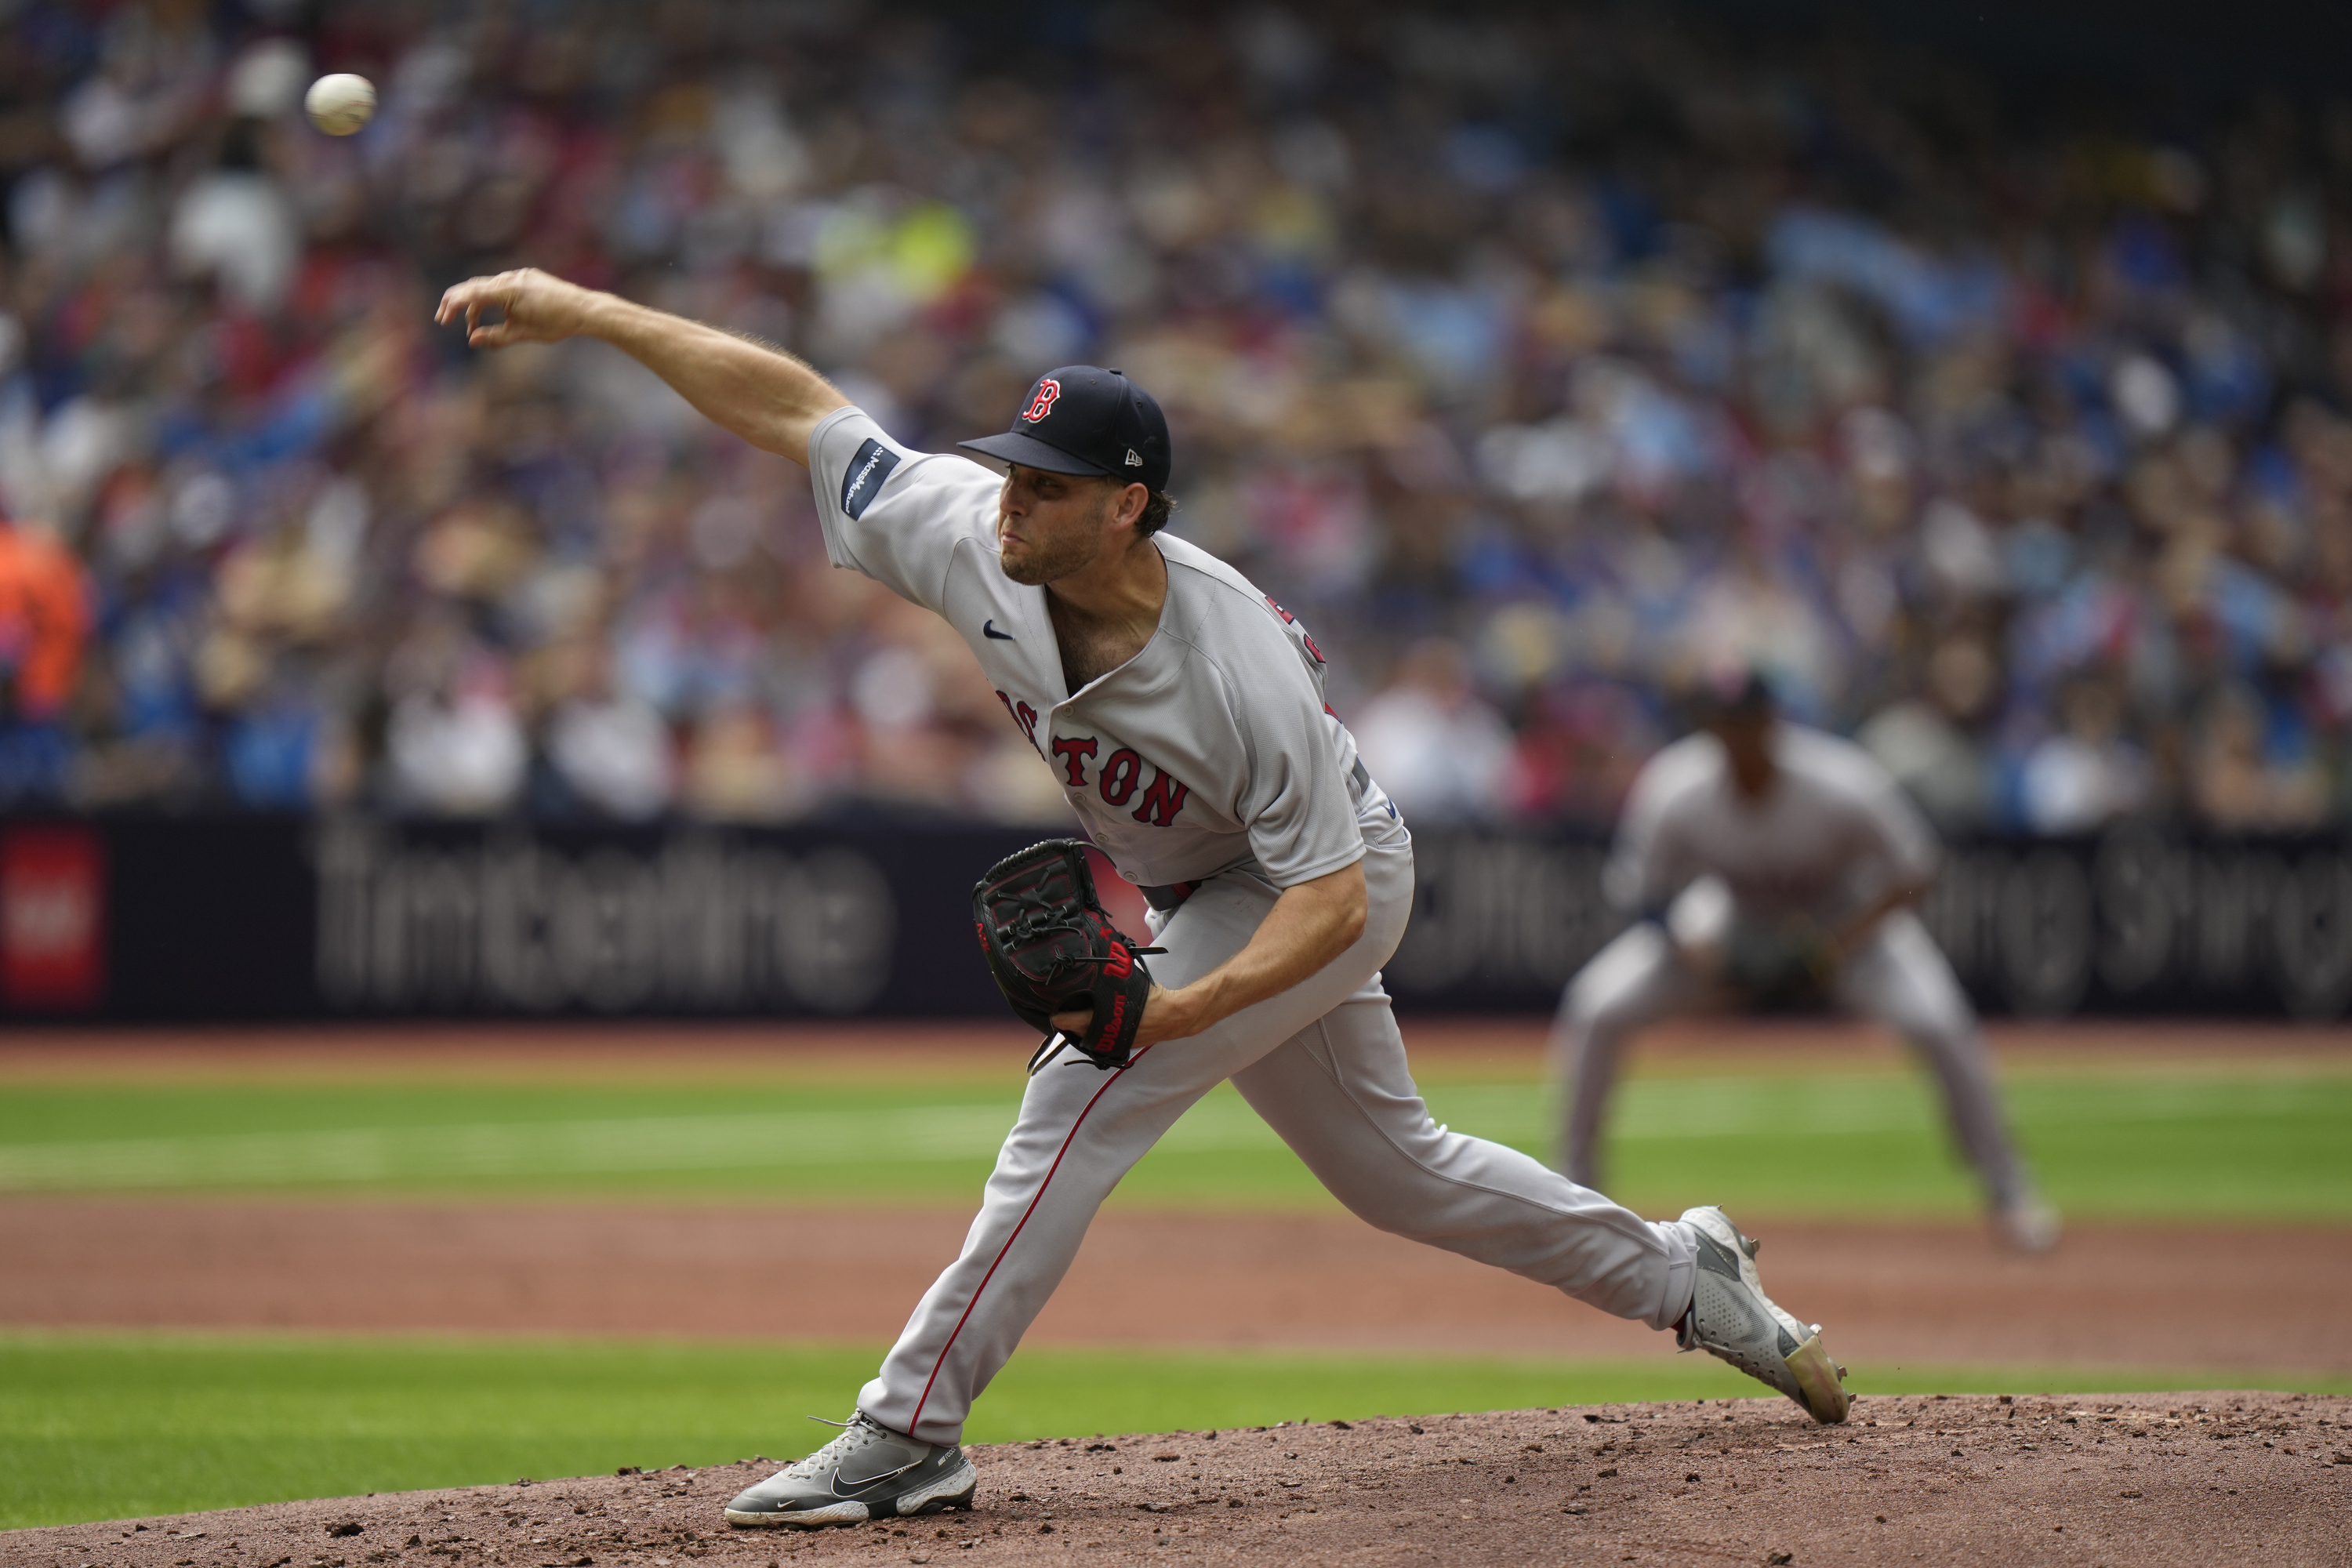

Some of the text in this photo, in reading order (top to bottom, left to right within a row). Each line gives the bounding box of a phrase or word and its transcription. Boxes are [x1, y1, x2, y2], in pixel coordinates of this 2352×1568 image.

[1022, 379, 1061, 424] B
[846, 456, 880, 514] MassMutual
[1094, 994, 1127, 1052] Wilson
